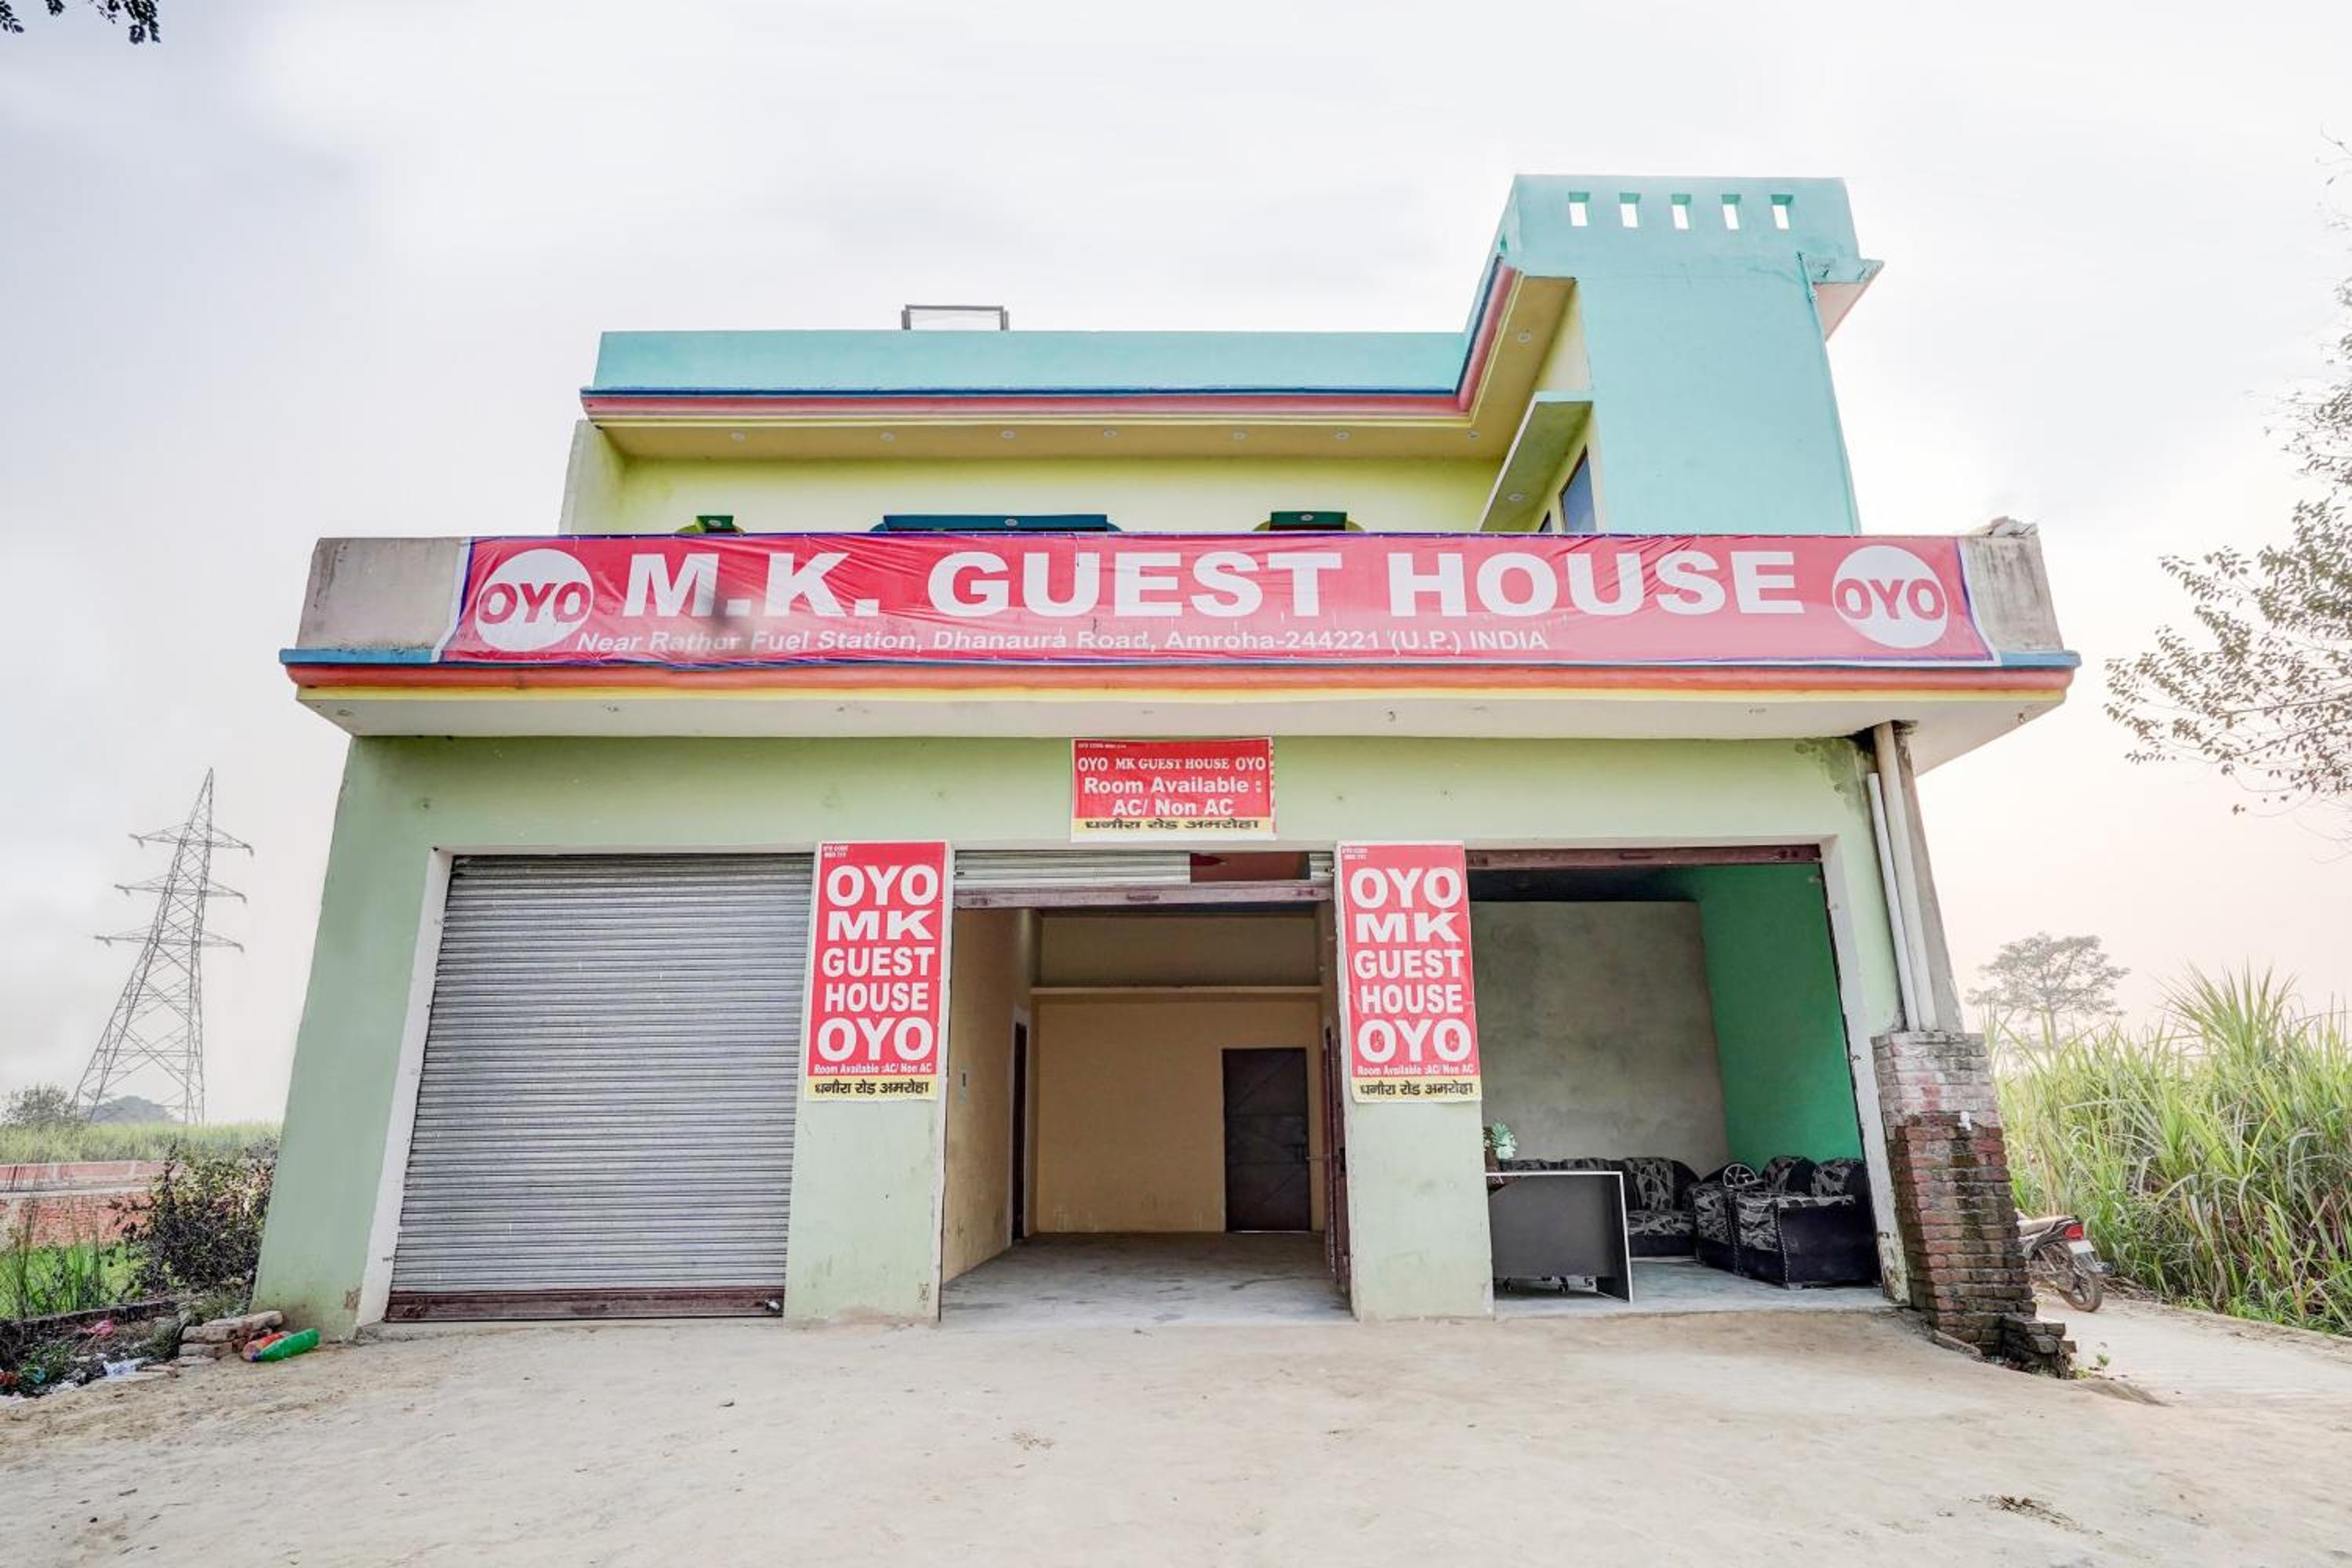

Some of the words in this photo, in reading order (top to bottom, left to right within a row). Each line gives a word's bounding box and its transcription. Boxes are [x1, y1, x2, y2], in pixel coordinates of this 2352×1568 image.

[623, 552, 880, 618] M.K.
[928, 551, 1342, 619] GUEST
[1388, 551, 1804, 619] HOUSE
[1835, 579, 1946, 620] OYO
[478, 582, 591, 625] OYO
[576, 630, 641, 652] Near
[650, 630, 741, 652] Rathor
[752, 630, 808, 652] Fuel
[818, 630, 923, 655] Station,
[933, 630, 1066, 652] Dhanaura
[1080, 630, 1156, 654] Road,
[1167, 630, 1379, 652] Amroha-244221
[1471, 630, 1550, 650] INDIA
[1078, 757, 1109, 772] OYO
[1116, 758, 1136, 770] MK
[1138, 758, 1181, 770] GUEST
[1185, 758, 1229, 770] HOUSE
[1236, 757, 1266, 771] OYO
[1084, 777, 1143, 793] Room
[1151, 776, 1249, 793] Available
[1112, 800, 1148, 816] AC/
[1156, 800, 1197, 816] Non
[1204, 799, 1234, 816] AC
[826, 865, 939, 907] OYO
[1350, 866, 1463, 909] OYO
[827, 910, 935, 942] MK
[1356, 912, 1461, 943] MK
[822, 947, 935, 978] GUEST
[1354, 949, 1465, 980] GUEST
[824, 982, 929, 1013] HOUSE
[1360, 984, 1464, 1014] HOUSE
[817, 1017, 934, 1062] OYO
[1357, 1018, 1472, 1064] OYO
[815, 1064, 838, 1073] Room
[840, 1064, 879, 1073] Available
[901, 1063, 917, 1073] Non
[920, 1062, 932, 1073] AC
[1357, 1066, 1381, 1076] Room
[1461, 1065, 1475, 1074] AC
[879, 1079, 930, 1094] अमरोहा
